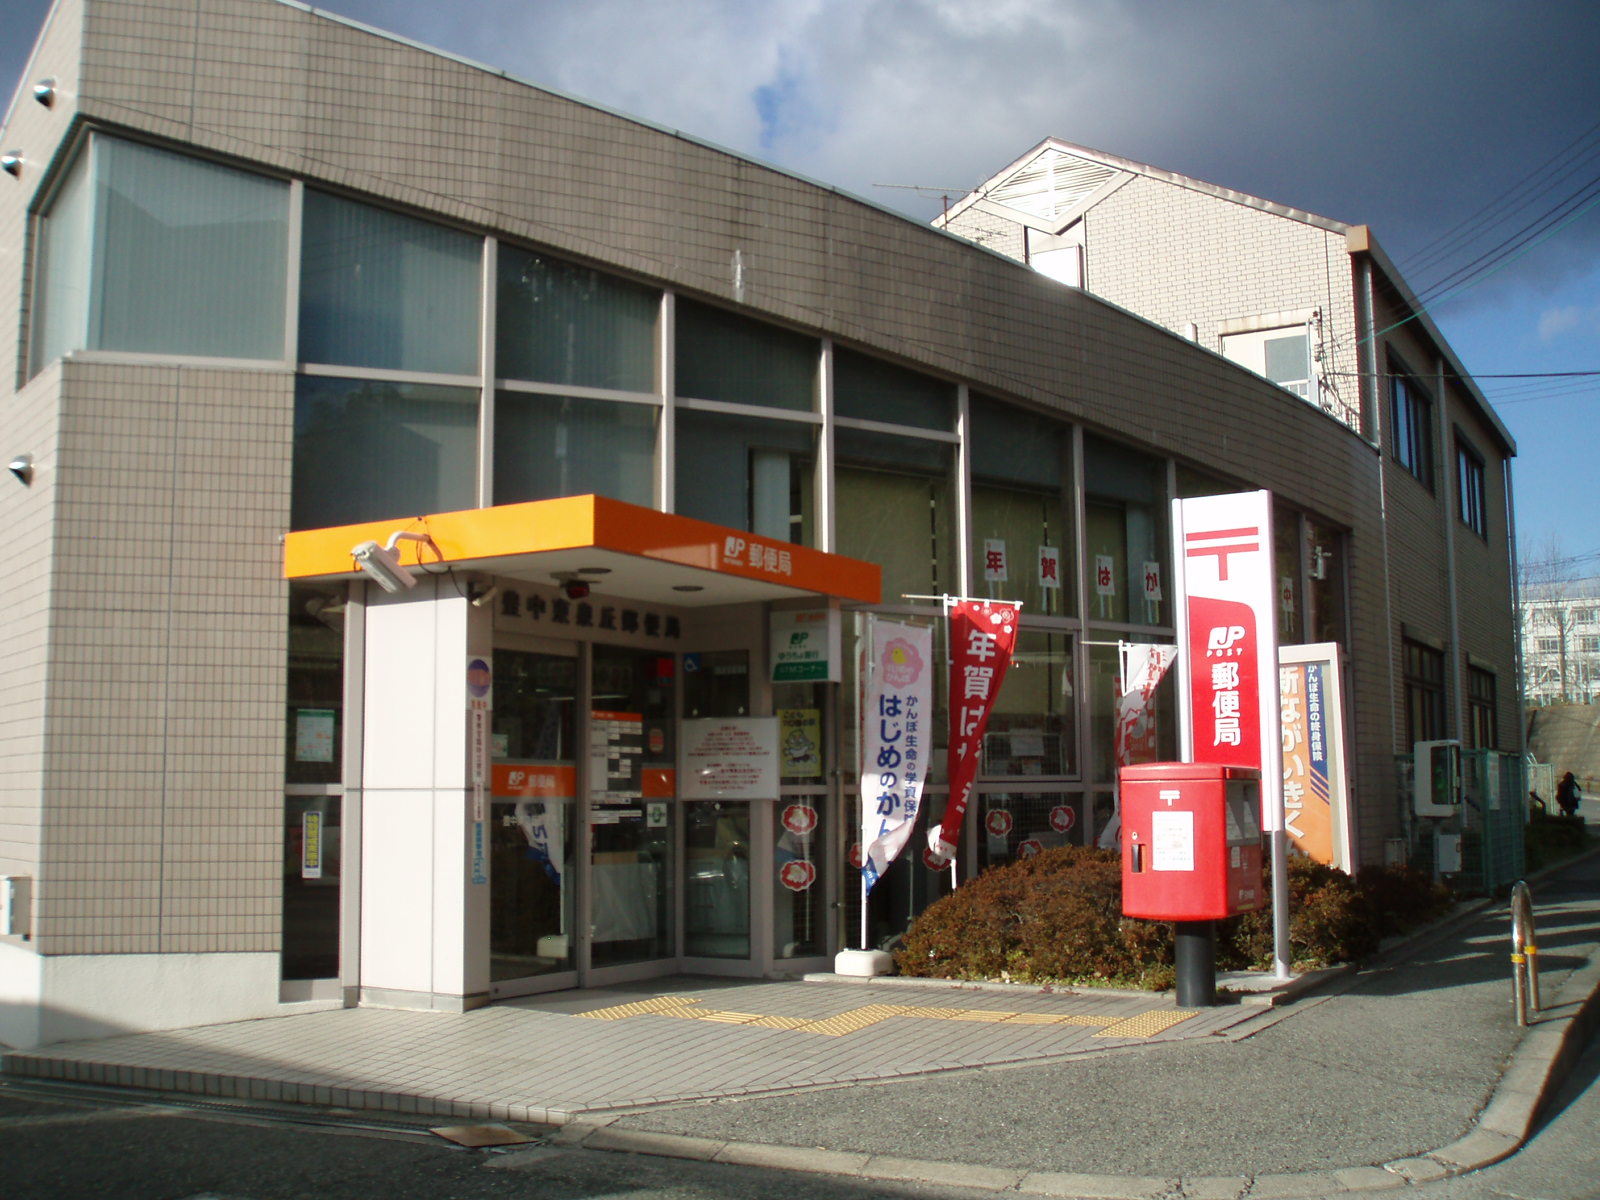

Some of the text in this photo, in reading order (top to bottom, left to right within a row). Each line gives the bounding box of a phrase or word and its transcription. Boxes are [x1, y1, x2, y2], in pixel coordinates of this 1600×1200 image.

[749, 543, 793, 576] 郵便局
[986, 550, 1005, 573] 年
[1041, 557, 1057, 581] 賀
[1098, 566, 1112, 586] は
[1206, 648, 1244, 658] POST
[1211, 661, 1242, 747] 郵便局
